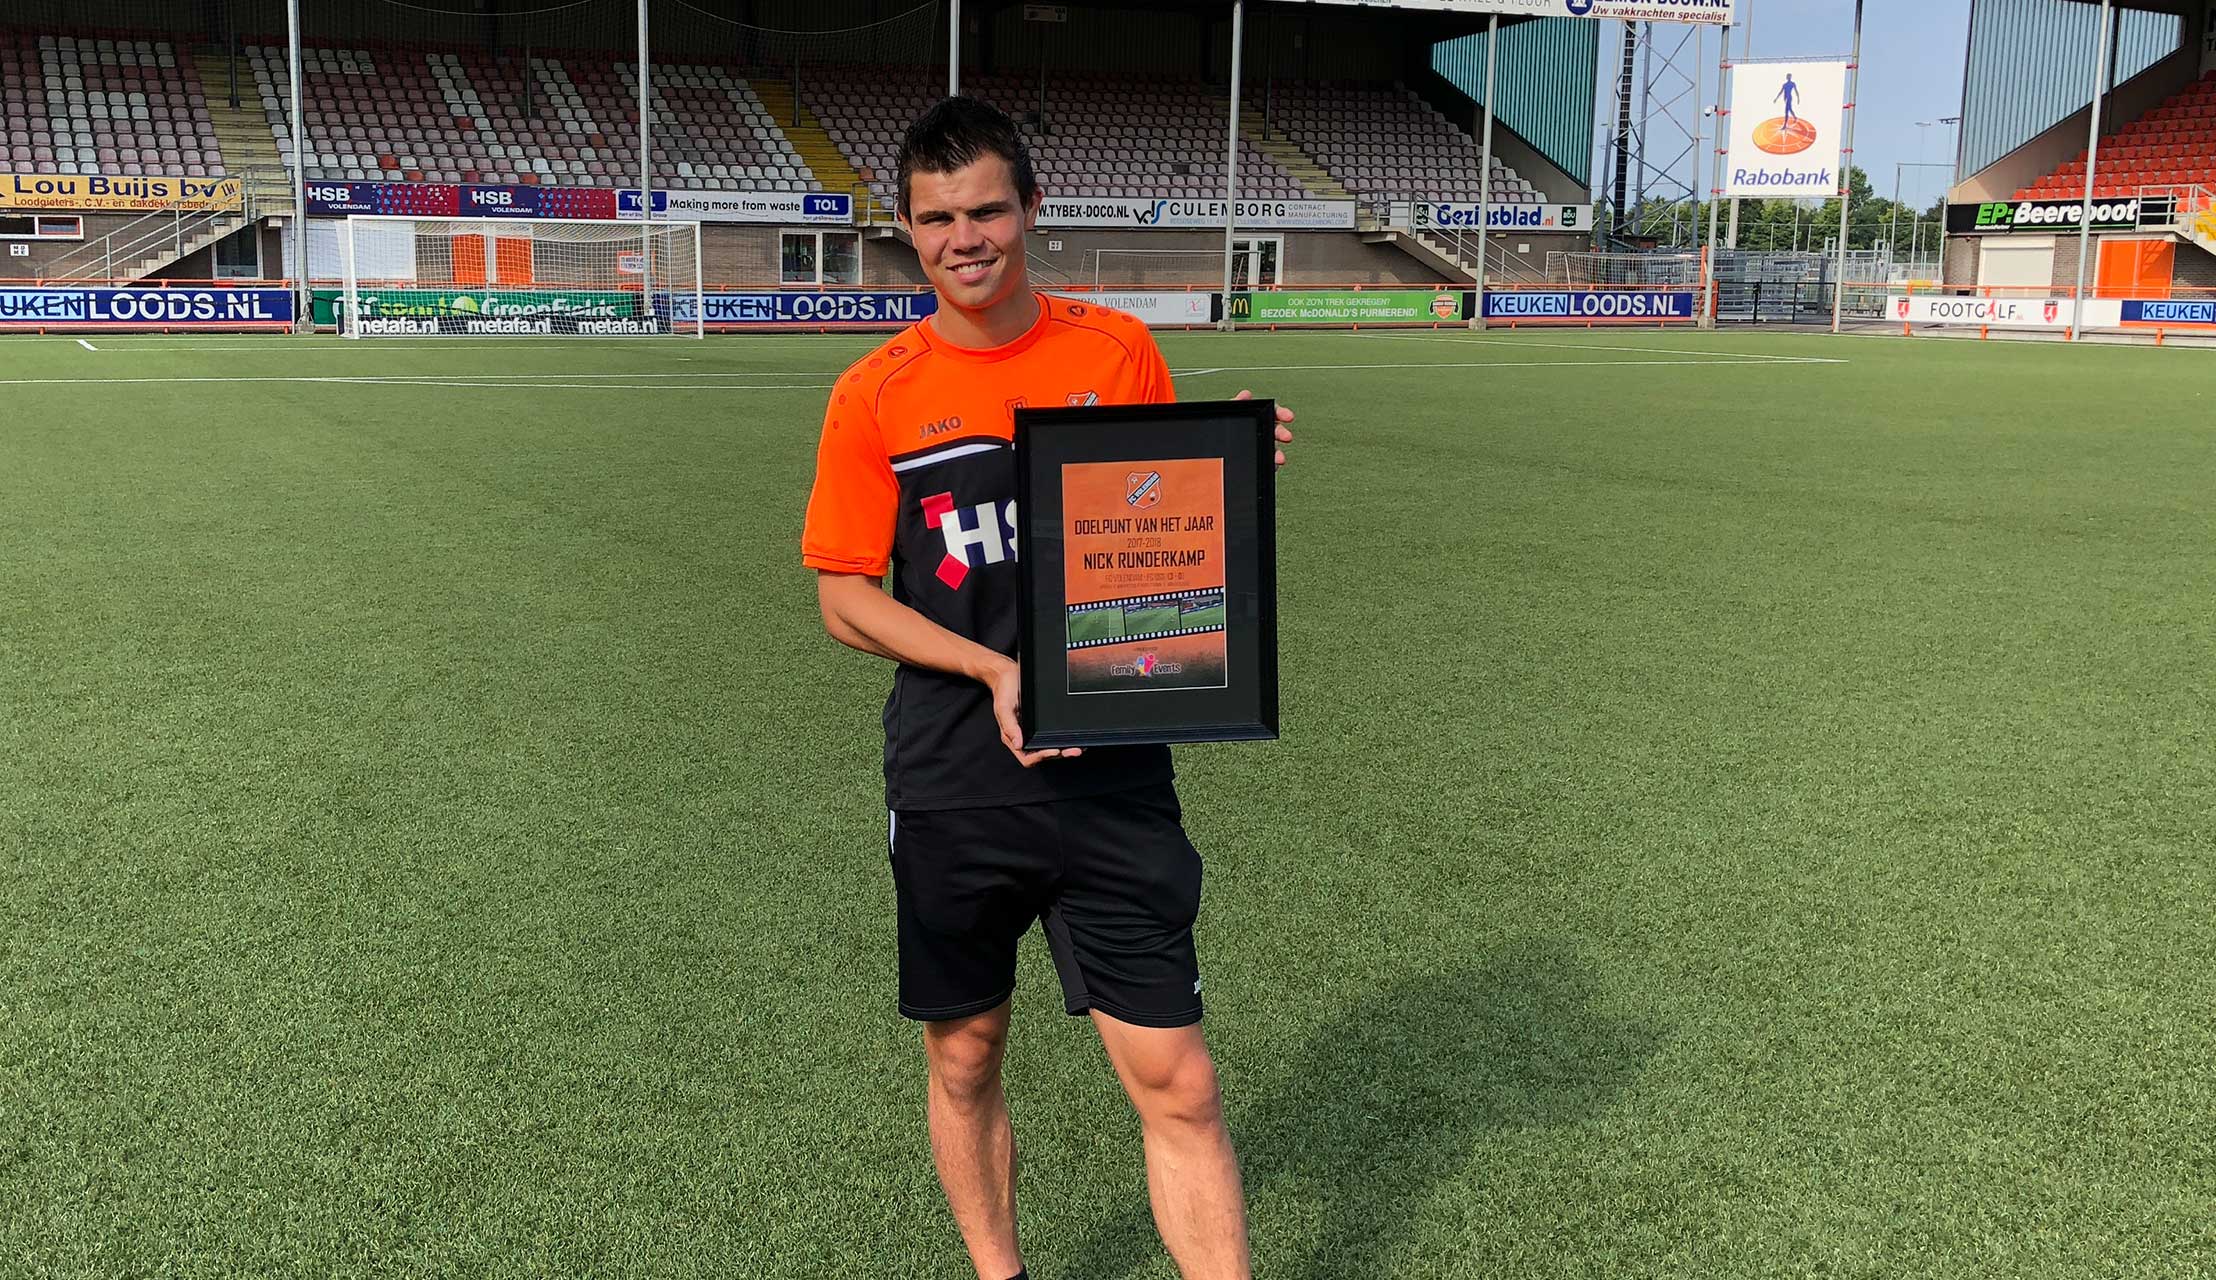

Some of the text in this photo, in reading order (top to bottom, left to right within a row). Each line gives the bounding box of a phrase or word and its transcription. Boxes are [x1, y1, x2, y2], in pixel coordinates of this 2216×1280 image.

[1592, 5, 1727, 22] Uw vakkrachten specialist
[1733, 167, 1831, 186] Rabobank
[14, 175, 218, 199] Lou Buijs bv
[307, 186, 351, 201] HSB
[471, 190, 513, 205] HSB
[112, 200, 125, 209] en
[328, 202, 372, 211] VOLENDAM
[491, 206, 533, 214] VOLENDAM
[669, 199, 801, 212] Making more from waste
[813, 199, 839, 211] TOL
[1288, 203, 1326, 211] CONTRACT
[1288, 211, 1348, 219] MANUFACTURING
[1104, 297, 1157, 309] VOLENDAM
[1287, 297, 1305, 306] OOK
[1324, 297, 1345, 306] TREK
[1346, 297, 1391, 306] GEKREGEN?
[1260, 308, 1418, 318] BEZOEK McDONALD'S PURMEREND!
[2143, 304, 2212, 320] KEUKEN
[466, 317, 550, 335] metafa.nl
[577, 317, 659, 335] metafa.nl
[919, 415, 962, 440] JAKO
[1074, 515, 1214, 535] DOELPUNT VAN HET JAAR
[1127, 537, 1162, 549] 2017-2018
[1083, 549, 1206, 570] NICK RUNDERKAMP
[1153, 663, 1182, 674] Events
